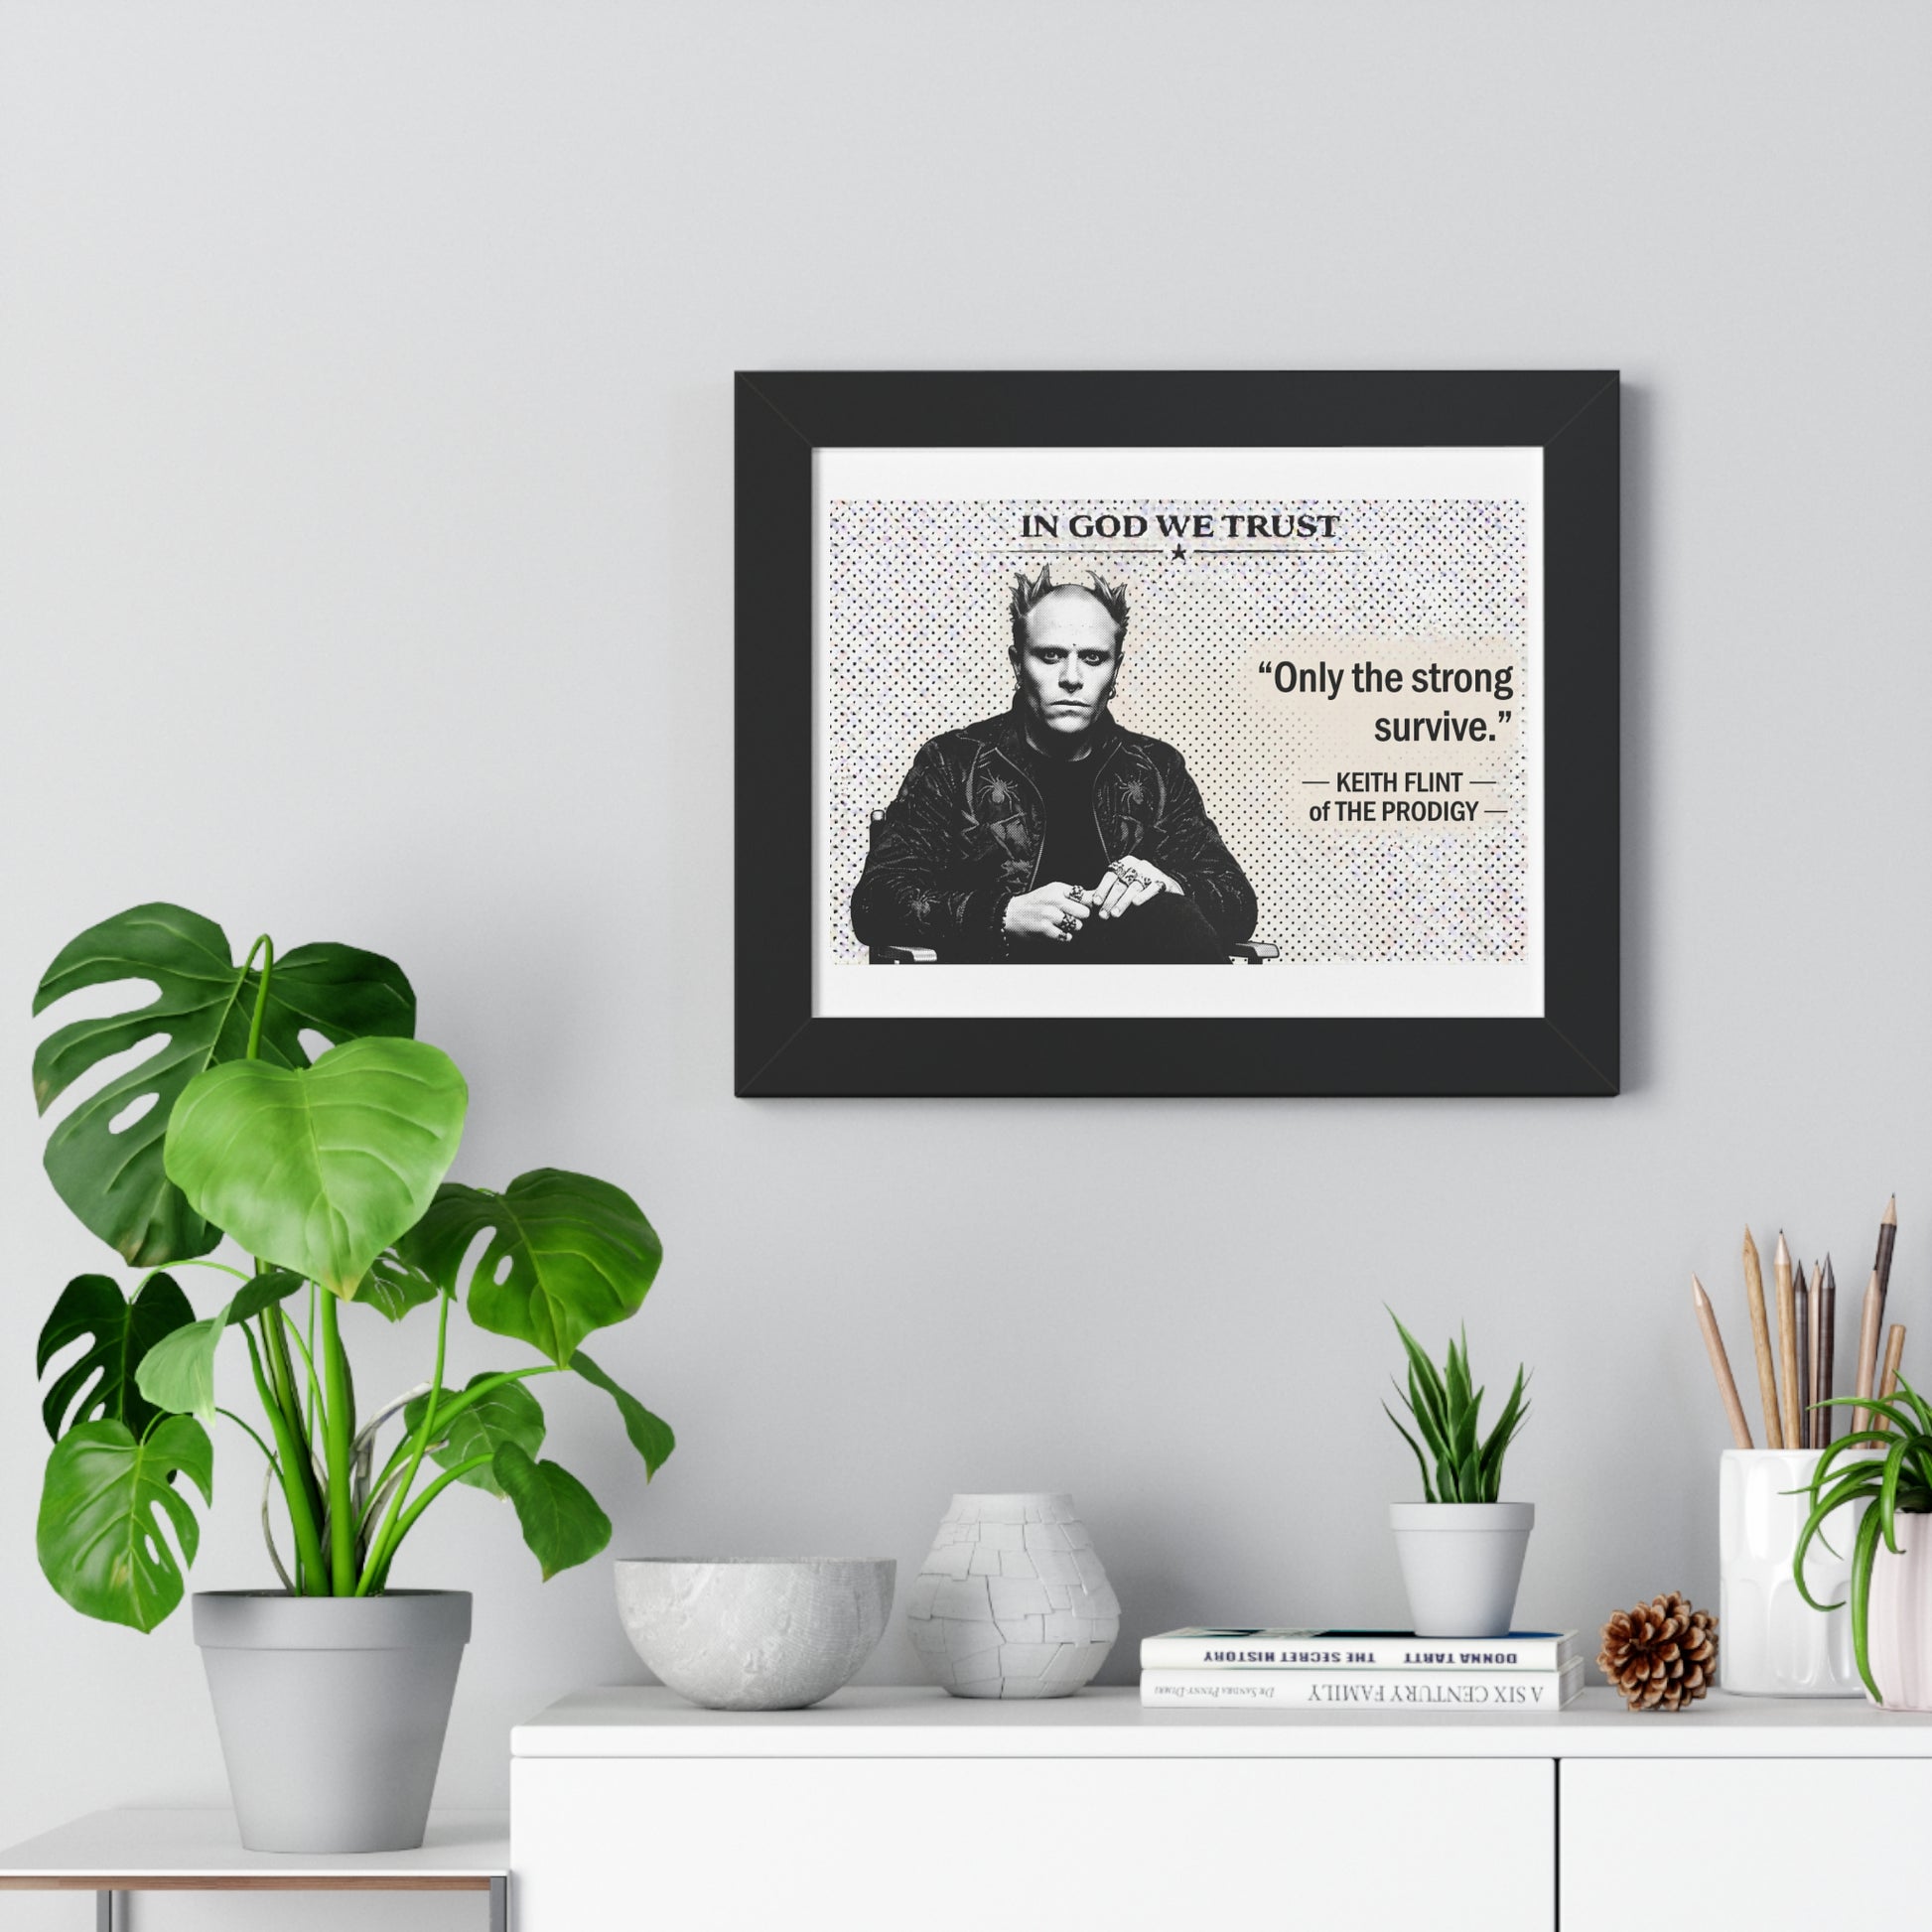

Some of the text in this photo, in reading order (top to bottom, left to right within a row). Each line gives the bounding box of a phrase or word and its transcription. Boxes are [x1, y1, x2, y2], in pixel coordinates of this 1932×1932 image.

[1021, 514, 1341, 538] IN GOD WE TRUST
[1258, 660, 1514, 701] “Only the strong
[1374, 710, 1512, 743] survive.”
[1336, 771, 1463, 792] KEITH FLINT
[1309, 800, 1479, 822] of THE PRODIGY
[1203, 1651, 1376, 1663] THE SECRET HISTORY
[1404, 1652, 1518, 1665] DONNA TARTT
[1309, 1684, 1544, 1704] A SIX CENTURY FAMILY
